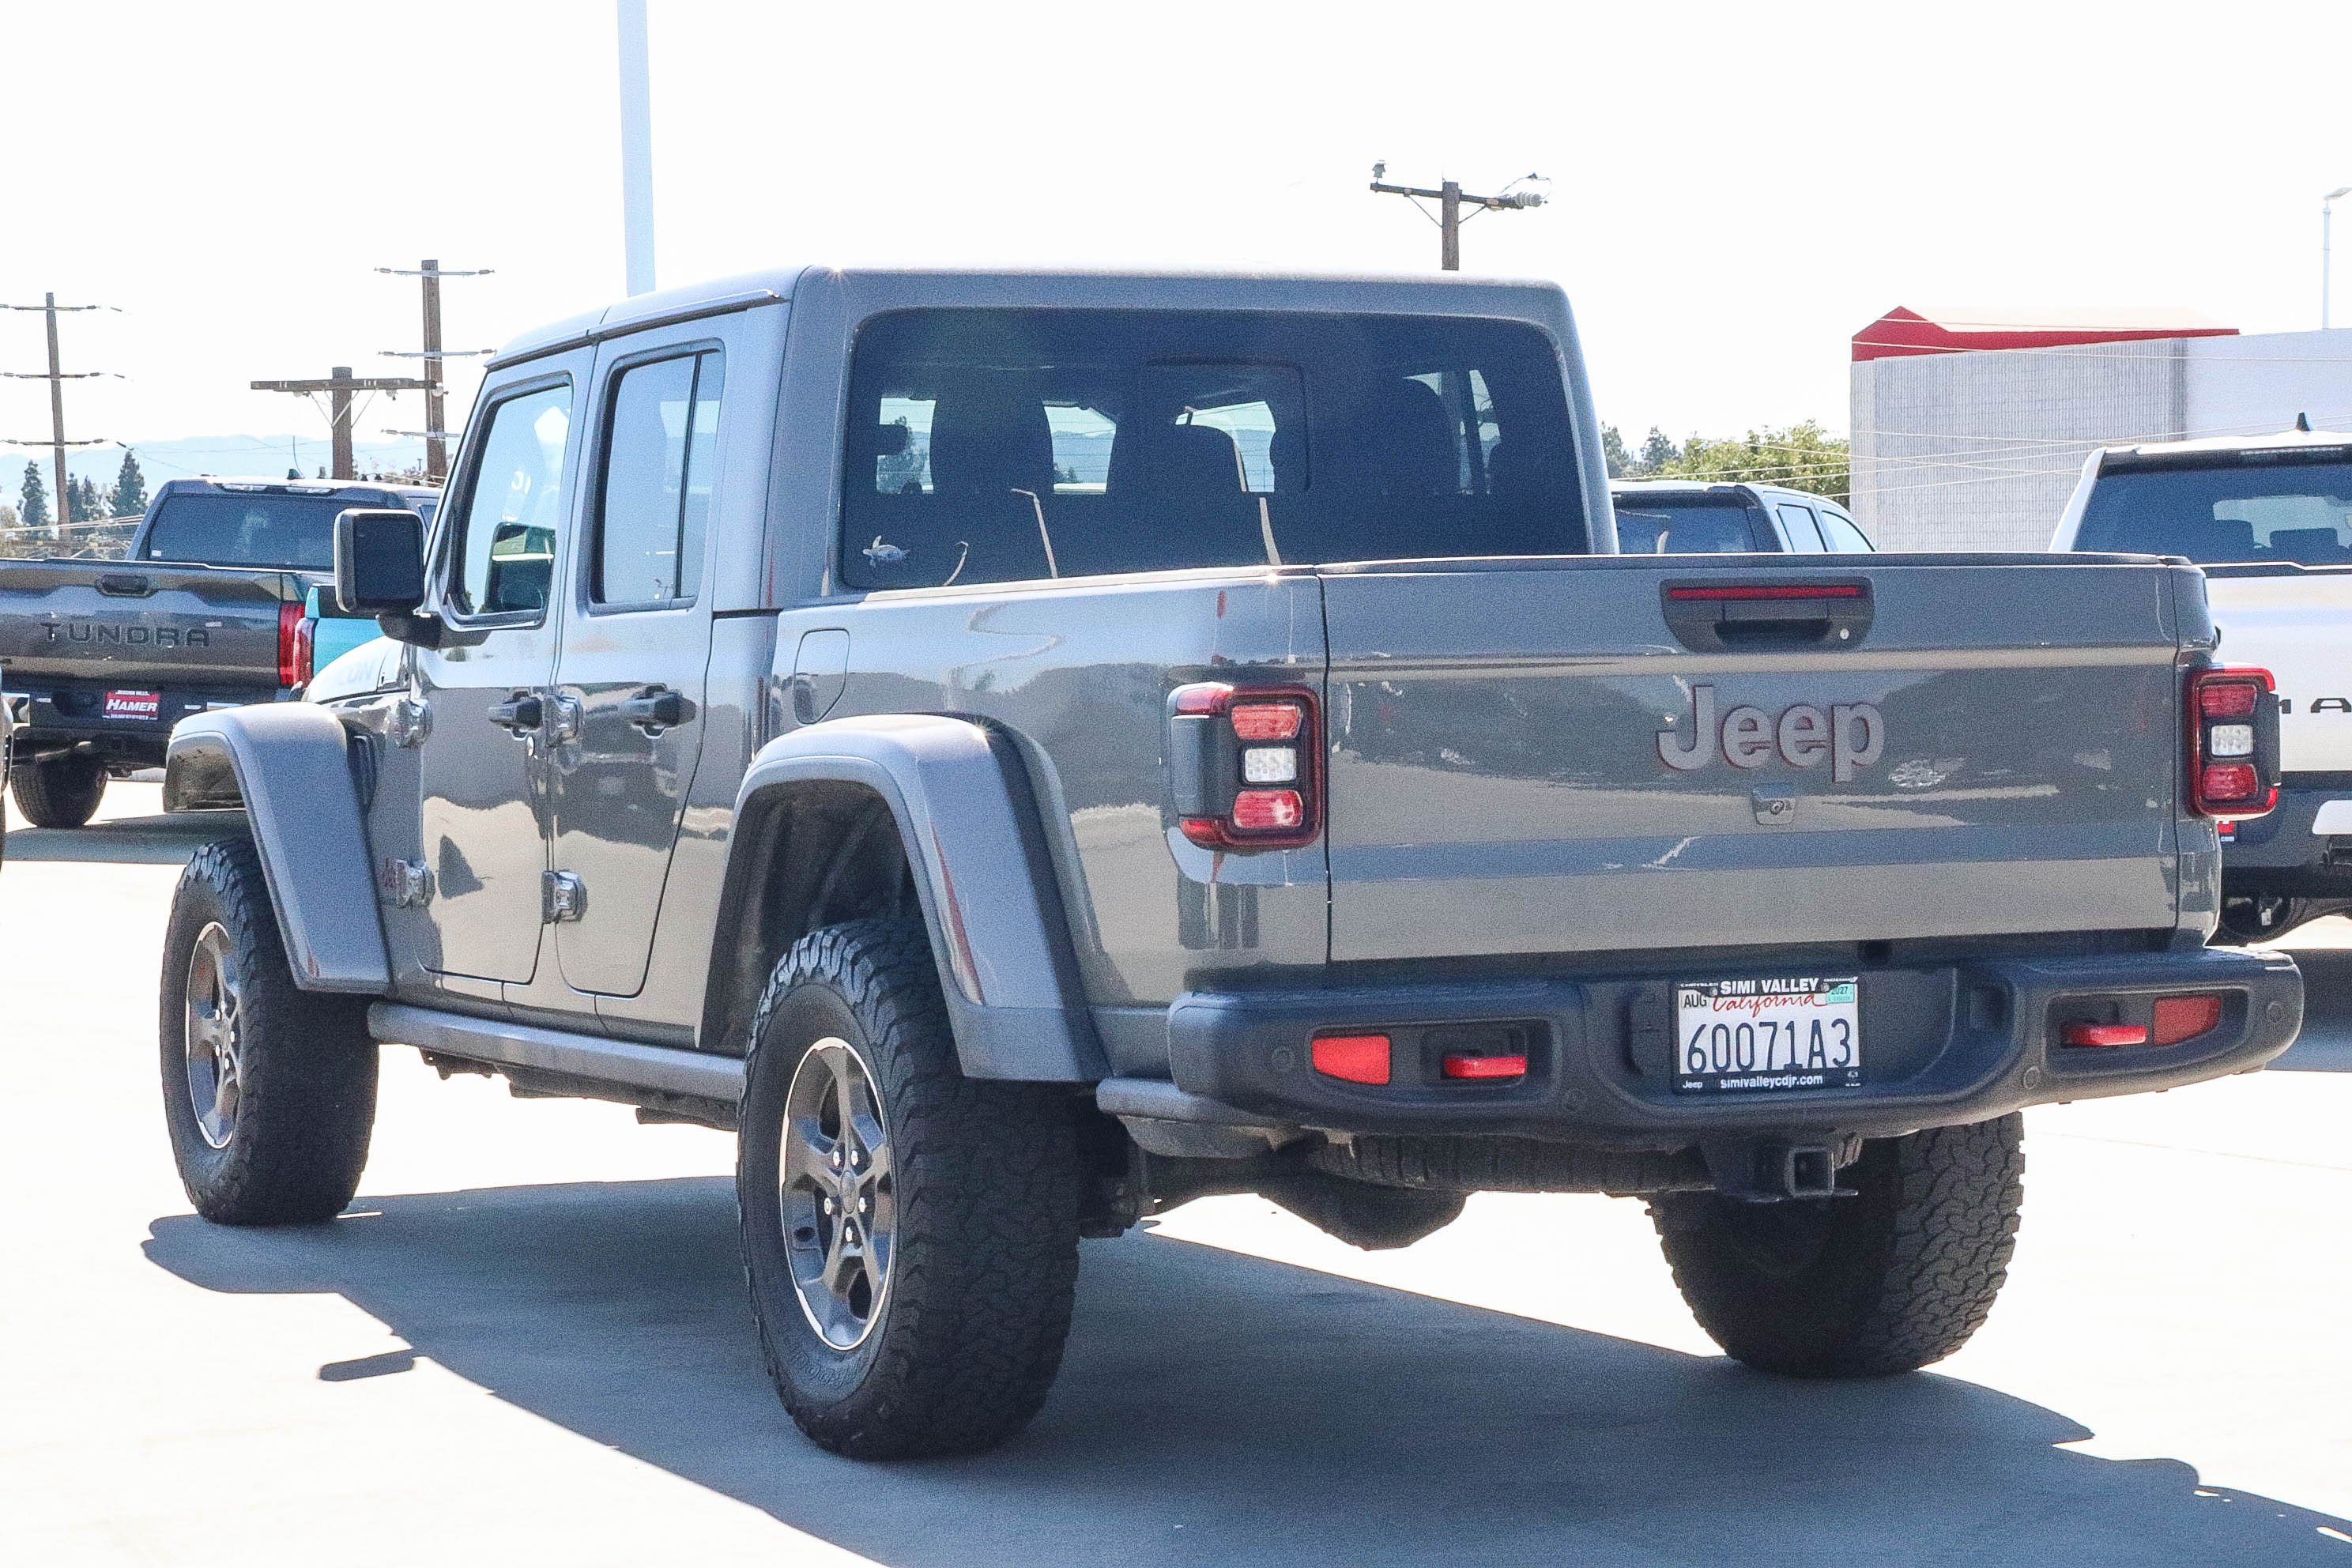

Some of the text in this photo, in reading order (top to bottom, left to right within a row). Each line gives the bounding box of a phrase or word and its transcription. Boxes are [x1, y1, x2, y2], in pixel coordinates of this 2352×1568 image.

[40, 621, 210, 646] TUNDRA
[106, 698, 158, 712] HAMER
[1657, 684, 1884, 783] Jeep
[1721, 978, 1819, 994] SIMI VALLEY
[1684, 995, 1707, 1008] AUG
[1713, 993, 1827, 1018] California
[1687, 1018, 1850, 1073] 60071A3
